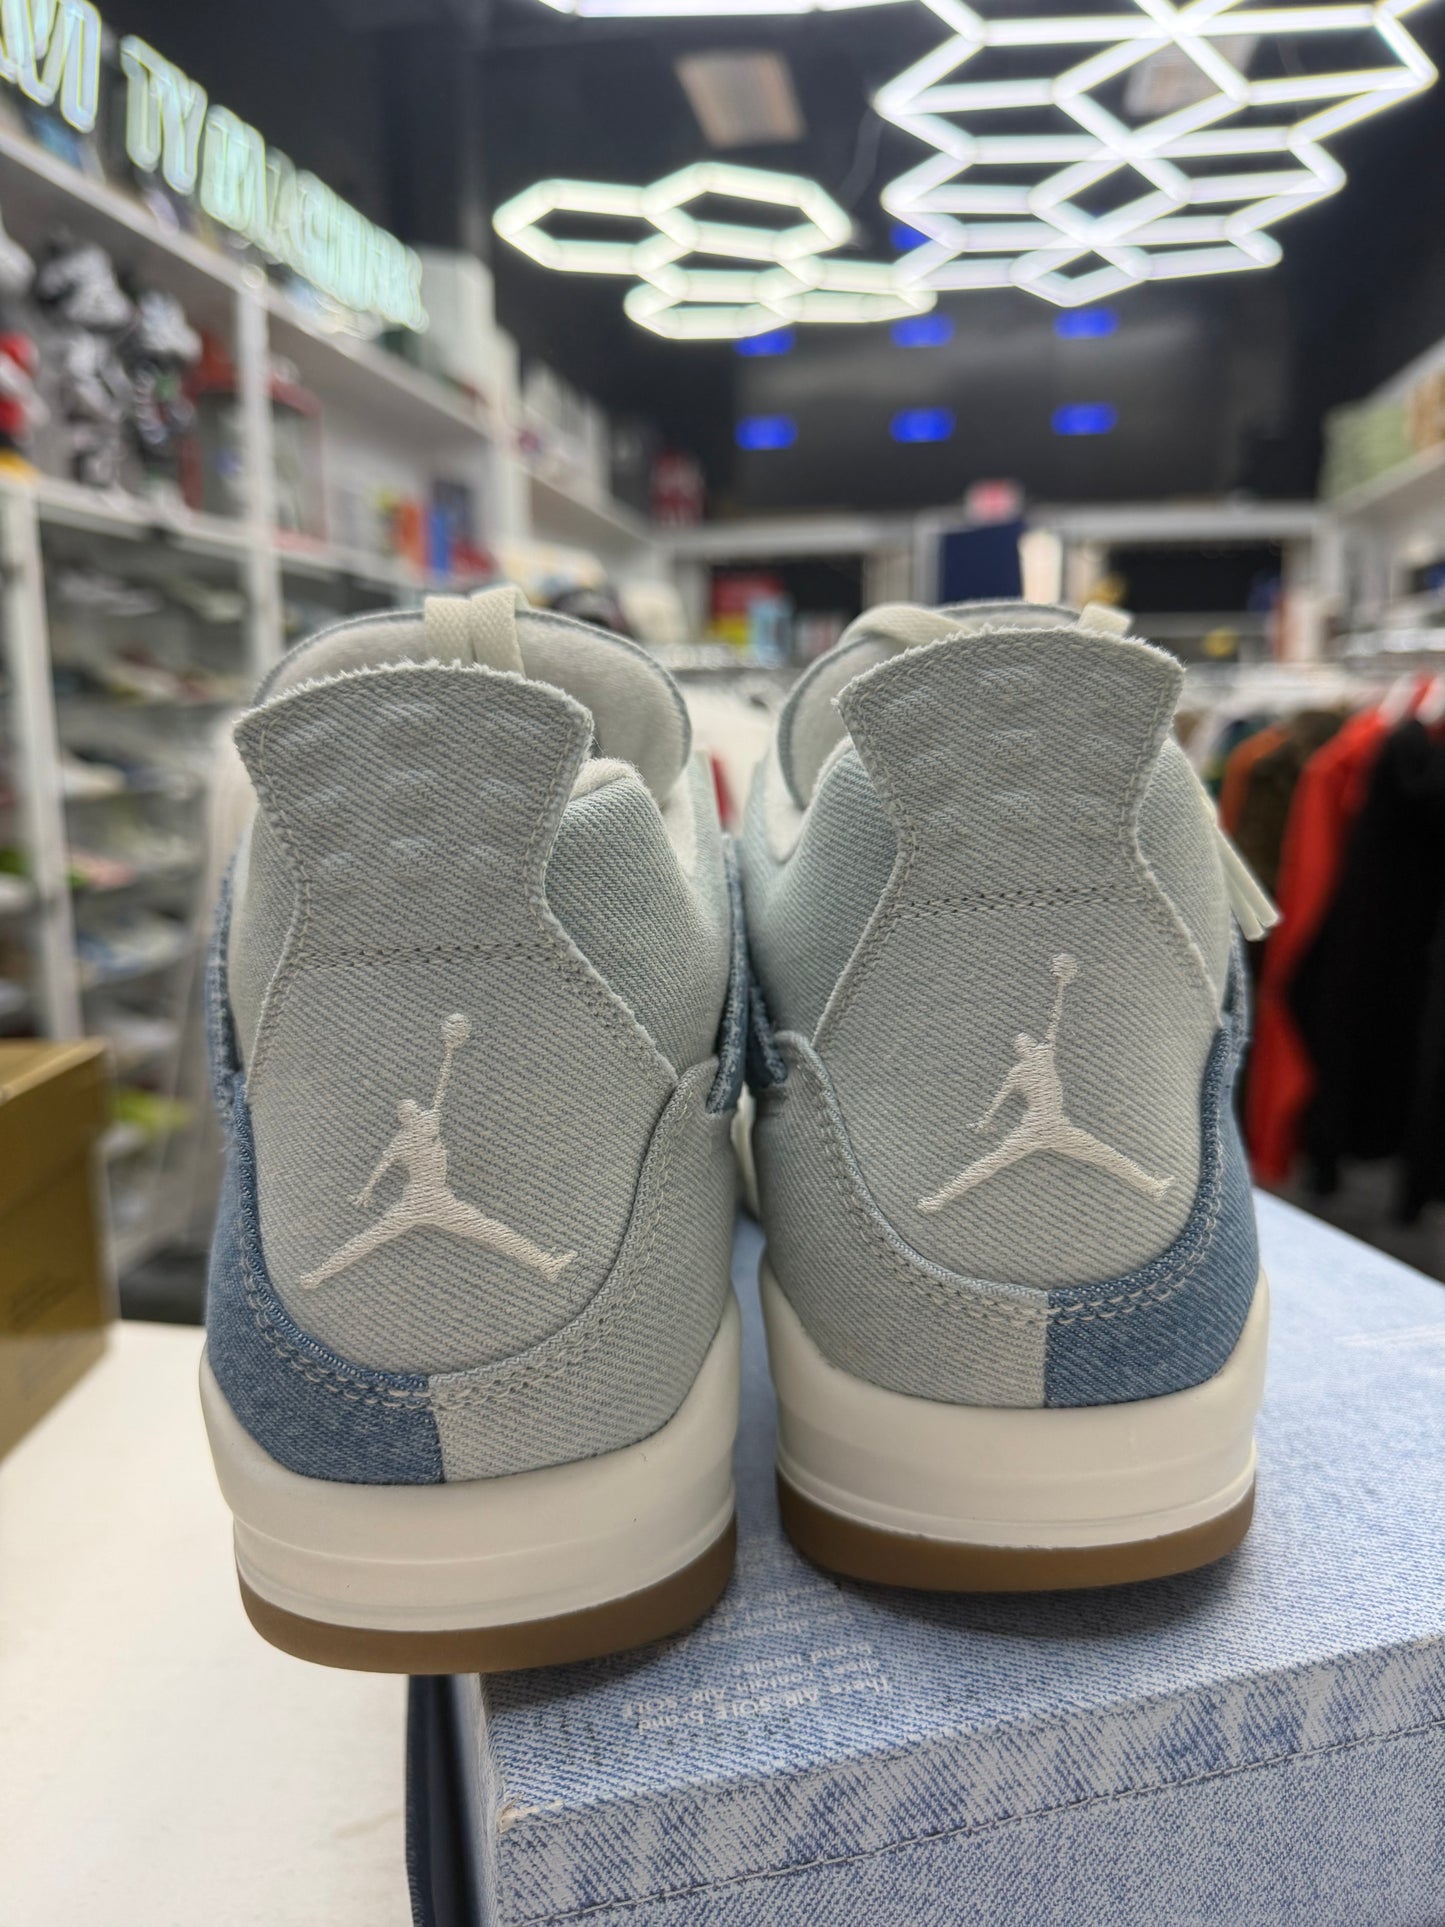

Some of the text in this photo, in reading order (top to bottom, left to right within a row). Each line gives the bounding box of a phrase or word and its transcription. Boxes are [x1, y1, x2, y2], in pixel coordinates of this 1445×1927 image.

[809, 1641, 872, 1663] brand
[828, 1676, 889, 1695] These
[637, 1709, 704, 1734] brand
